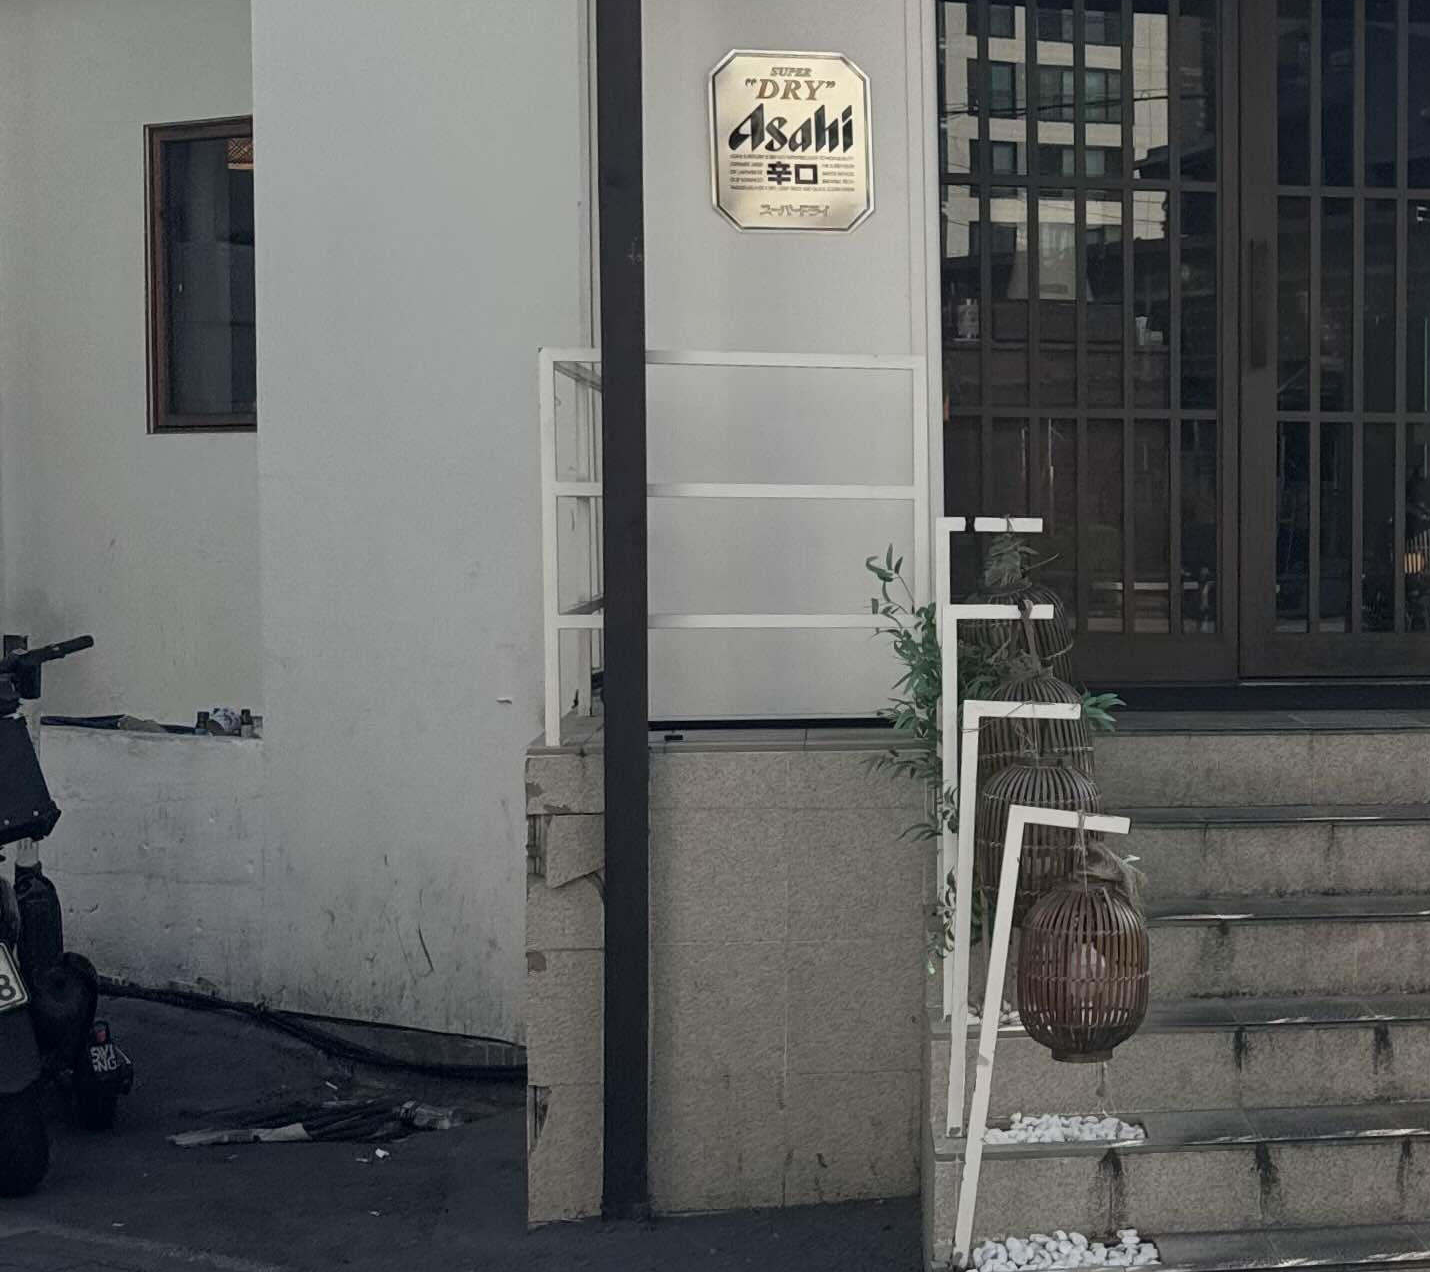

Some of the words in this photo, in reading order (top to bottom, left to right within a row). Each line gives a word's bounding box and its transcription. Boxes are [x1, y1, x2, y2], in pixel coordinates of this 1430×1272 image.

[771, 67, 812, 78] SUPER
[728, 103, 853, 153] Asahi
[766, 161, 819, 185] 辛口
